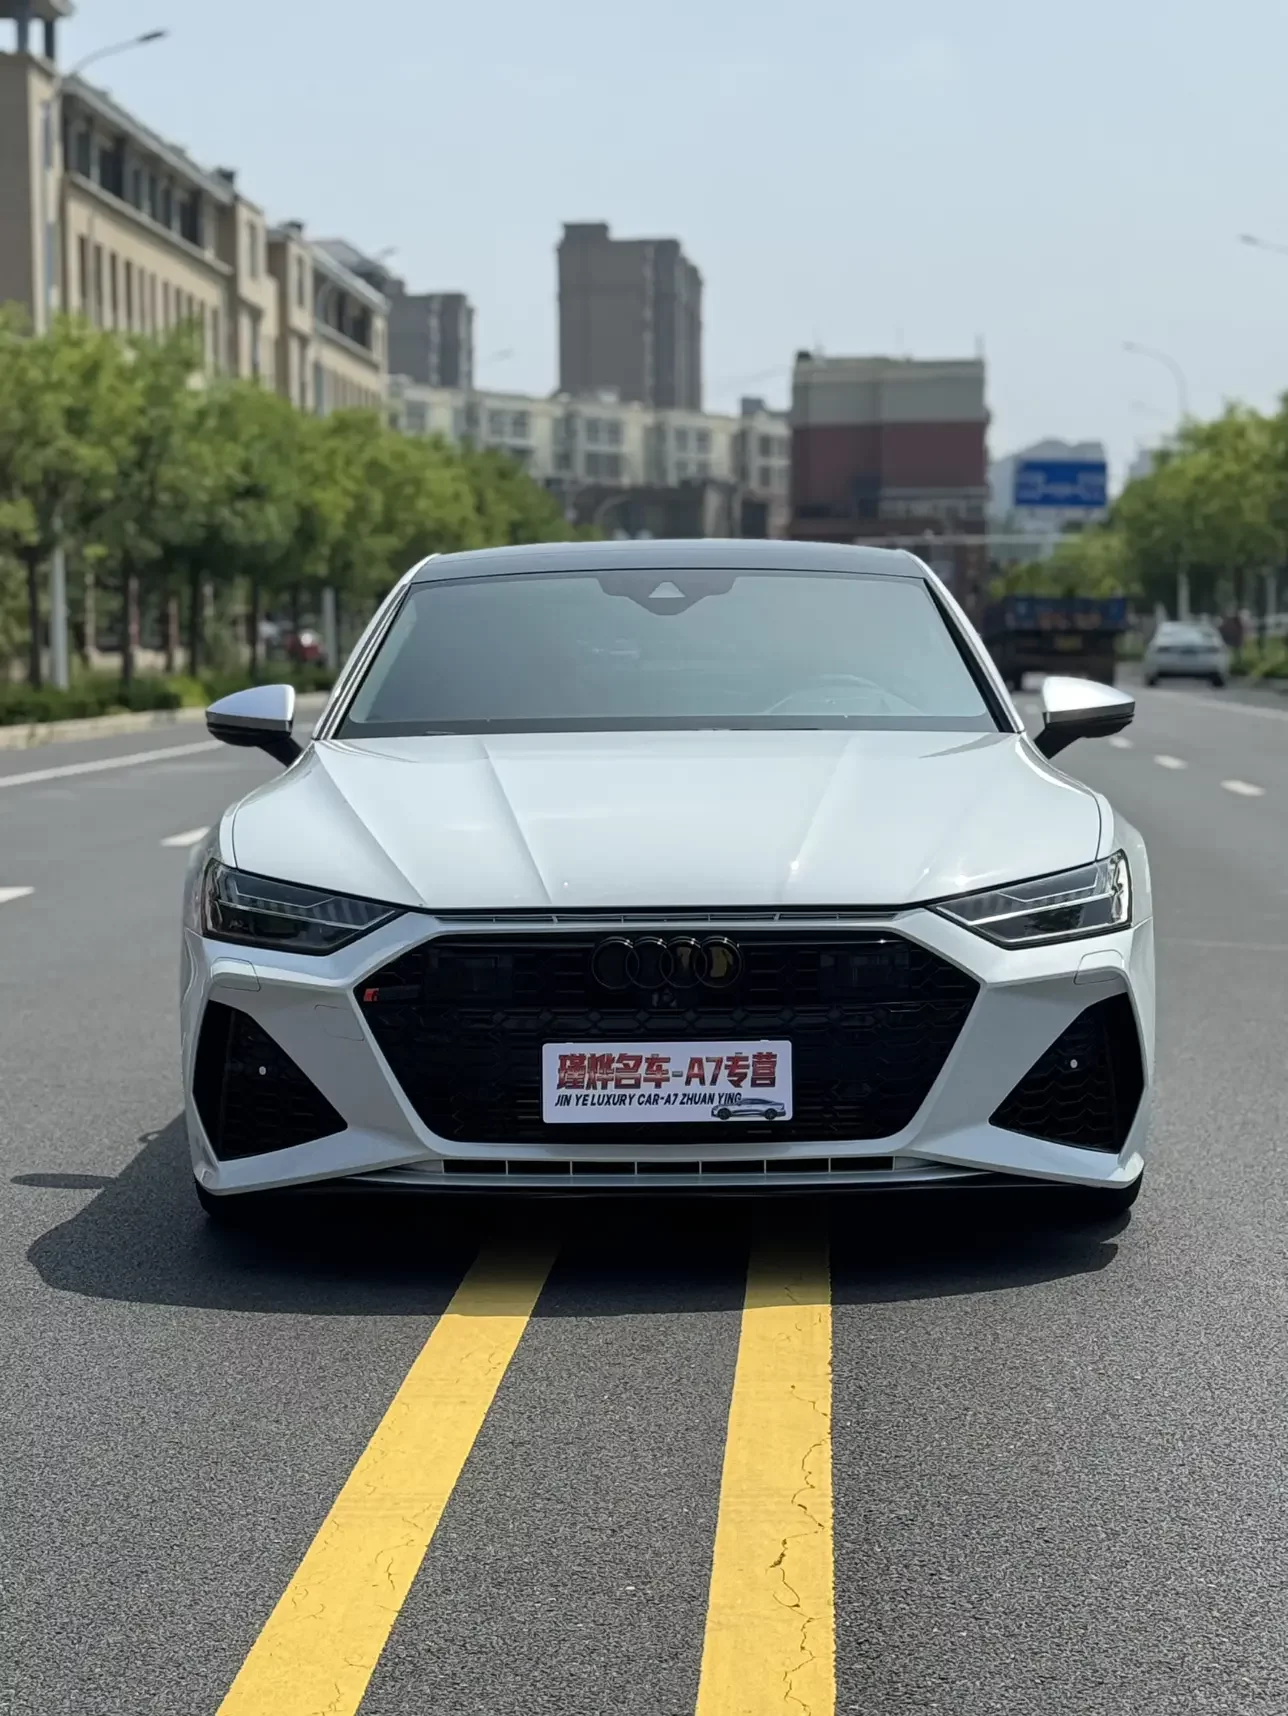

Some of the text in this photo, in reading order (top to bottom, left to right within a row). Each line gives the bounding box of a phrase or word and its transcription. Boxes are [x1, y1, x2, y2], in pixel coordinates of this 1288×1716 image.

[555, 1094, 572, 1107] JIN
[575, 1094, 590, 1106] YE
[590, 1094, 635, 1106] LUXURY
[637, 1093, 678, 1106] CAR-A7
[679, 1092, 715, 1105] ZHUAN
